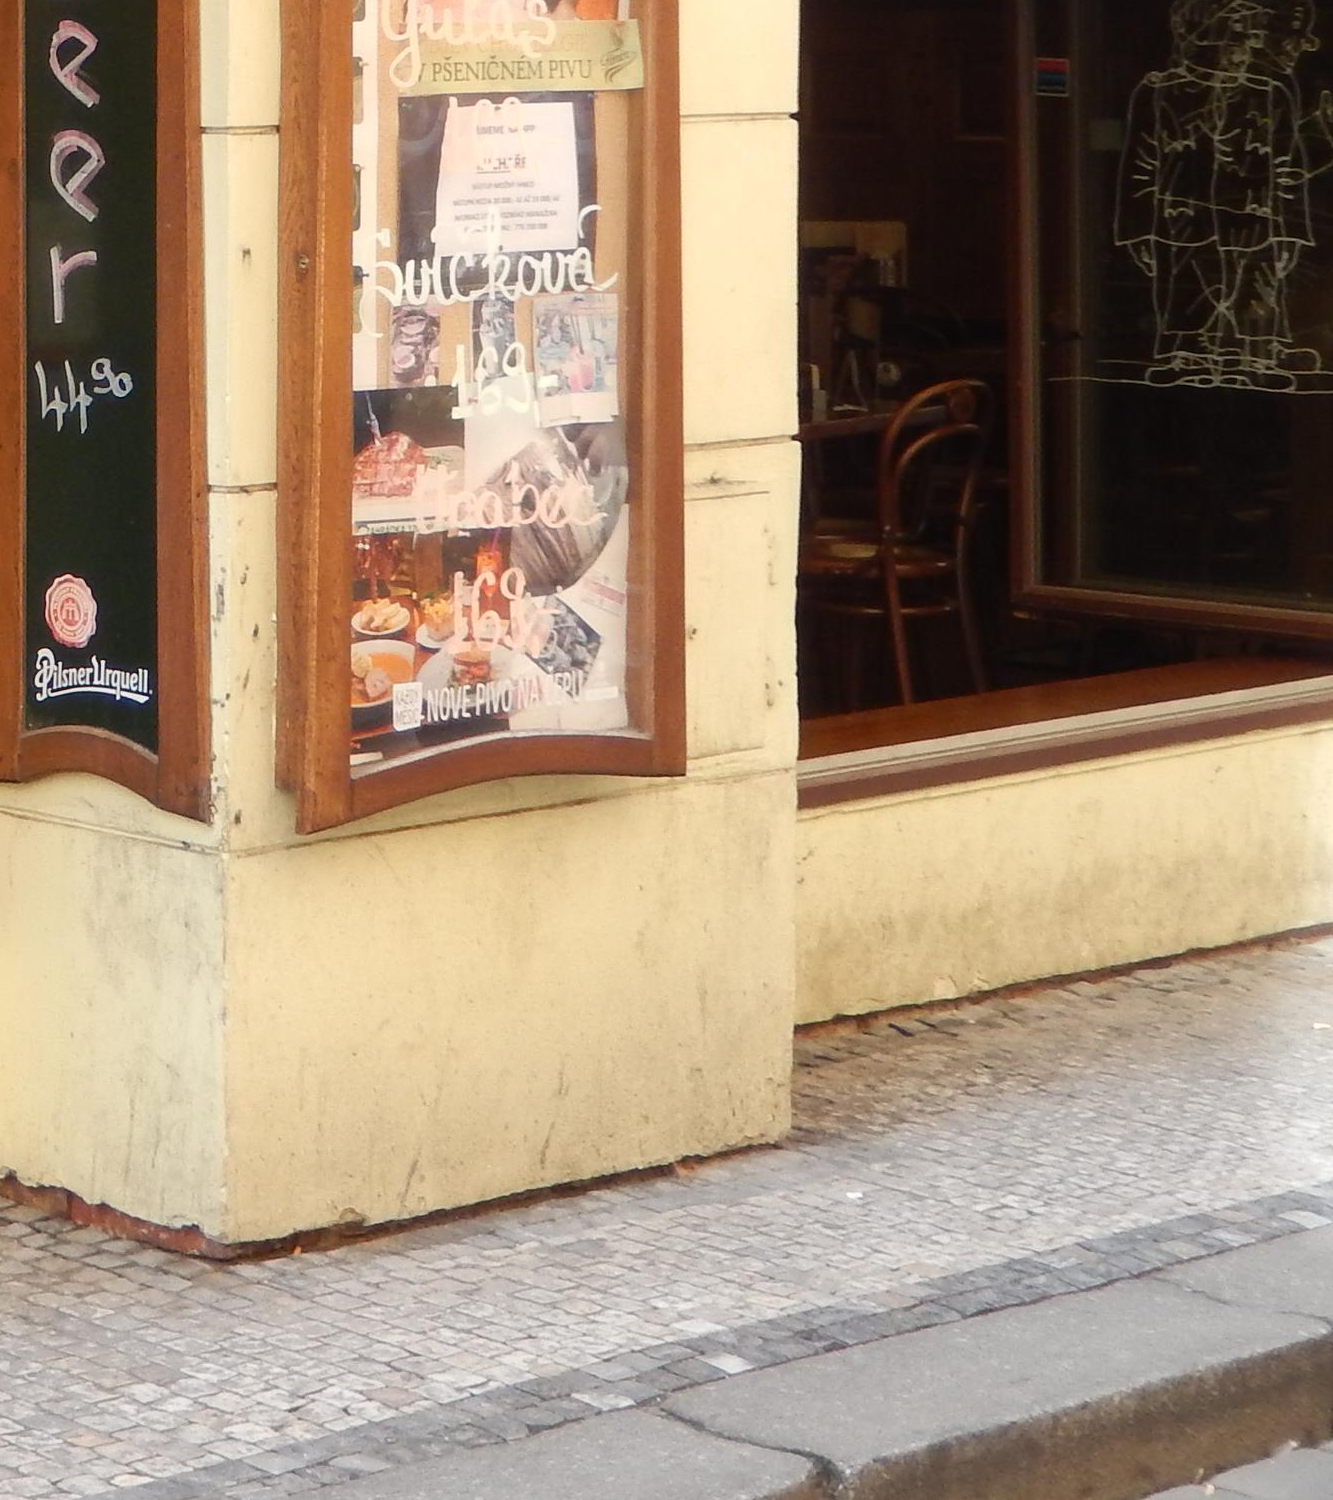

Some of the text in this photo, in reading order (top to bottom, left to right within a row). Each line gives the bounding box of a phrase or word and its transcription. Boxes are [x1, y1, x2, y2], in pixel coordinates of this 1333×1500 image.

[432, 54, 543, 83] PŠENIČNÉM
[548, 58, 593, 80] PIVU
[34, 648, 93, 701] Pilsner
[475, 679, 513, 717] PIVO
